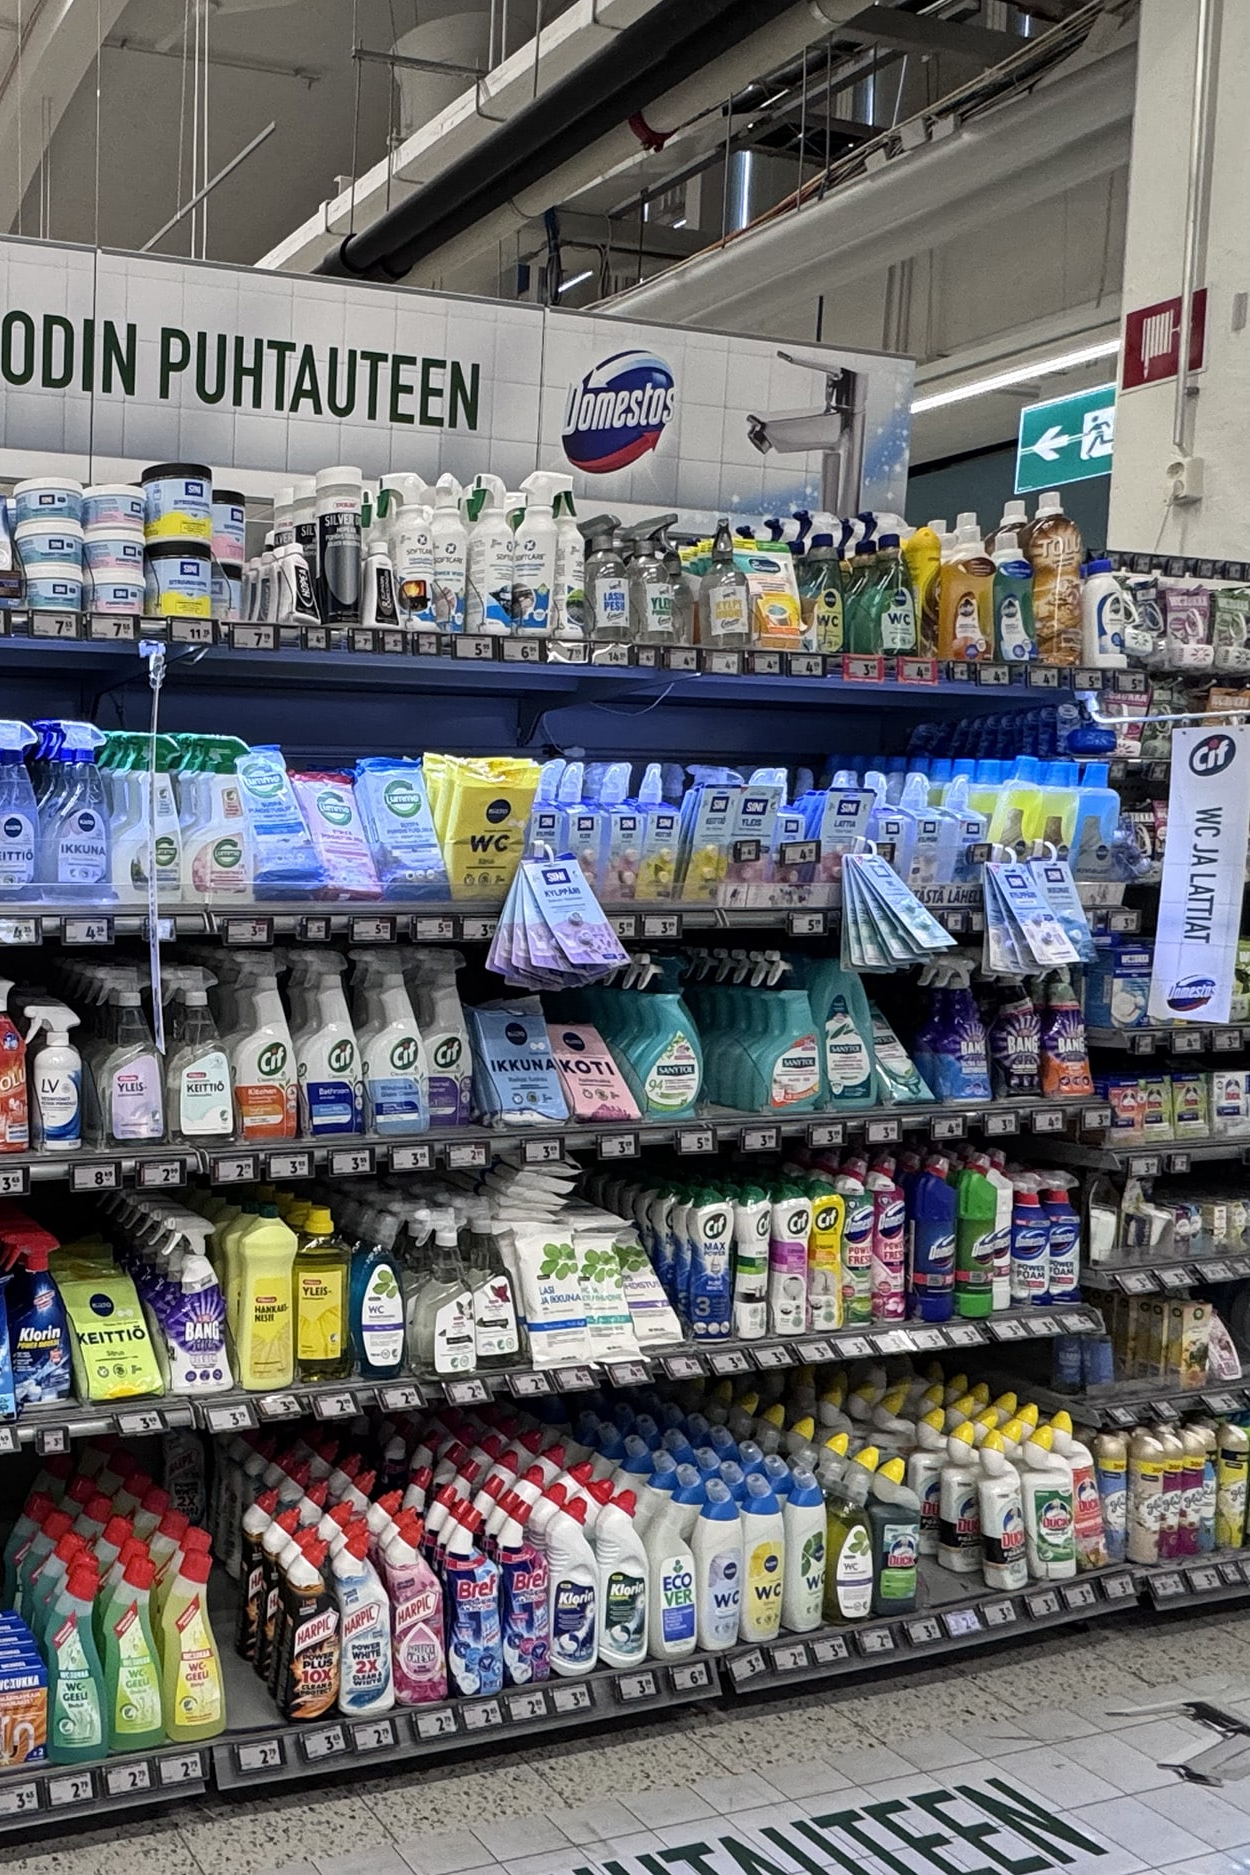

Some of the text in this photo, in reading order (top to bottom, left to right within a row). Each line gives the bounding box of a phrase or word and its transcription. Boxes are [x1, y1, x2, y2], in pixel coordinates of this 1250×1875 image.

[160, 327, 480, 430] PUHTAUTEEN
[562, 380, 676, 434] Domestos
[324, 513, 351, 527] SILVER
[888, 613, 910, 626] WC
[1192, 740, 1231, 770] Cif
[61, 844, 105, 856] IKKUNA
[470, 834, 510, 852] WC
[544, 871, 568, 883] SINI
[1183, 807, 1223, 944] WC JA LATTIAT
[830, 1044, 862, 1053] SANYTOL
[1007, 1037, 1038, 1053] BANG
[1059, 1038, 1084, 1053] BANG
[261, 1046, 284, 1072] Cif
[330, 1043, 351, 1069] Cif
[392, 1041, 416, 1067] Cif
[436, 1040, 460, 1065] Cif
[491, 1059, 557, 1072] IKKUNA
[562, 1059, 614, 1075] KOTI
[784, 1057, 815, 1067] SANYTOL
[658, 1064, 694, 1075] SANYTOL
[42, 1079, 59, 1093] LV
[187, 1080, 225, 1093] KEITTIÖ
[248, 1087, 277, 1095] Kitchen
[319, 1087, 350, 1095] Bathroom
[649, 1080, 663, 1091] 94
[706, 1217, 726, 1236] Cif
[703, 1242, 725, 1251] MAX
[703, 1249, 726, 1257] POWER
[1017, 1263, 1045, 1273] POWER
[1017, 1270, 1045, 1280] FOAM
[302, 1285, 332, 1297] YLEIS-
[540, 1286, 555, 1295] LASI
[540, 1293, 582, 1304] JA IKKUNA
[368, 1305, 384, 1314] WC
[695, 1296, 711, 1316] 3
[19, 1326, 61, 1343] Klorin
[78, 1328, 145, 1346] KEITTIÖ
[185, 1320, 220, 1342] BANG
[1043, 1516, 1071, 1528] DUCK
[844, 1562, 859, 1571] WC
[888, 1554, 915, 1568] DUCK
[512, 1570, 549, 1591] Bref
[663, 1572, 692, 1591] ECO
[457, 1580, 497, 1600] Bref
[610, 1580, 645, 1597] Klorin
[755, 1583, 781, 1599] WC
[558, 1590, 594, 1606] Klorin
[663, 1588, 692, 1608] VER
[714, 1591, 740, 1608] WC
[397, 1594, 432, 1626] HARPIC
[344, 1606, 376, 1637] HARPIC
[297, 1616, 331, 1646] HARPIC
[352, 1642, 381, 1652] POWER
[352, 1649, 381, 1659] WHITE
[302, 1653, 333, 1662] POWER
[303, 1659, 333, 1669] PLUS
[188, 1661, 208, 1674] WC-
[355, 1660, 379, 1673] 2X
[185, 1669, 209, 1683] GEELI
[301, 1669, 333, 1683] 10X
